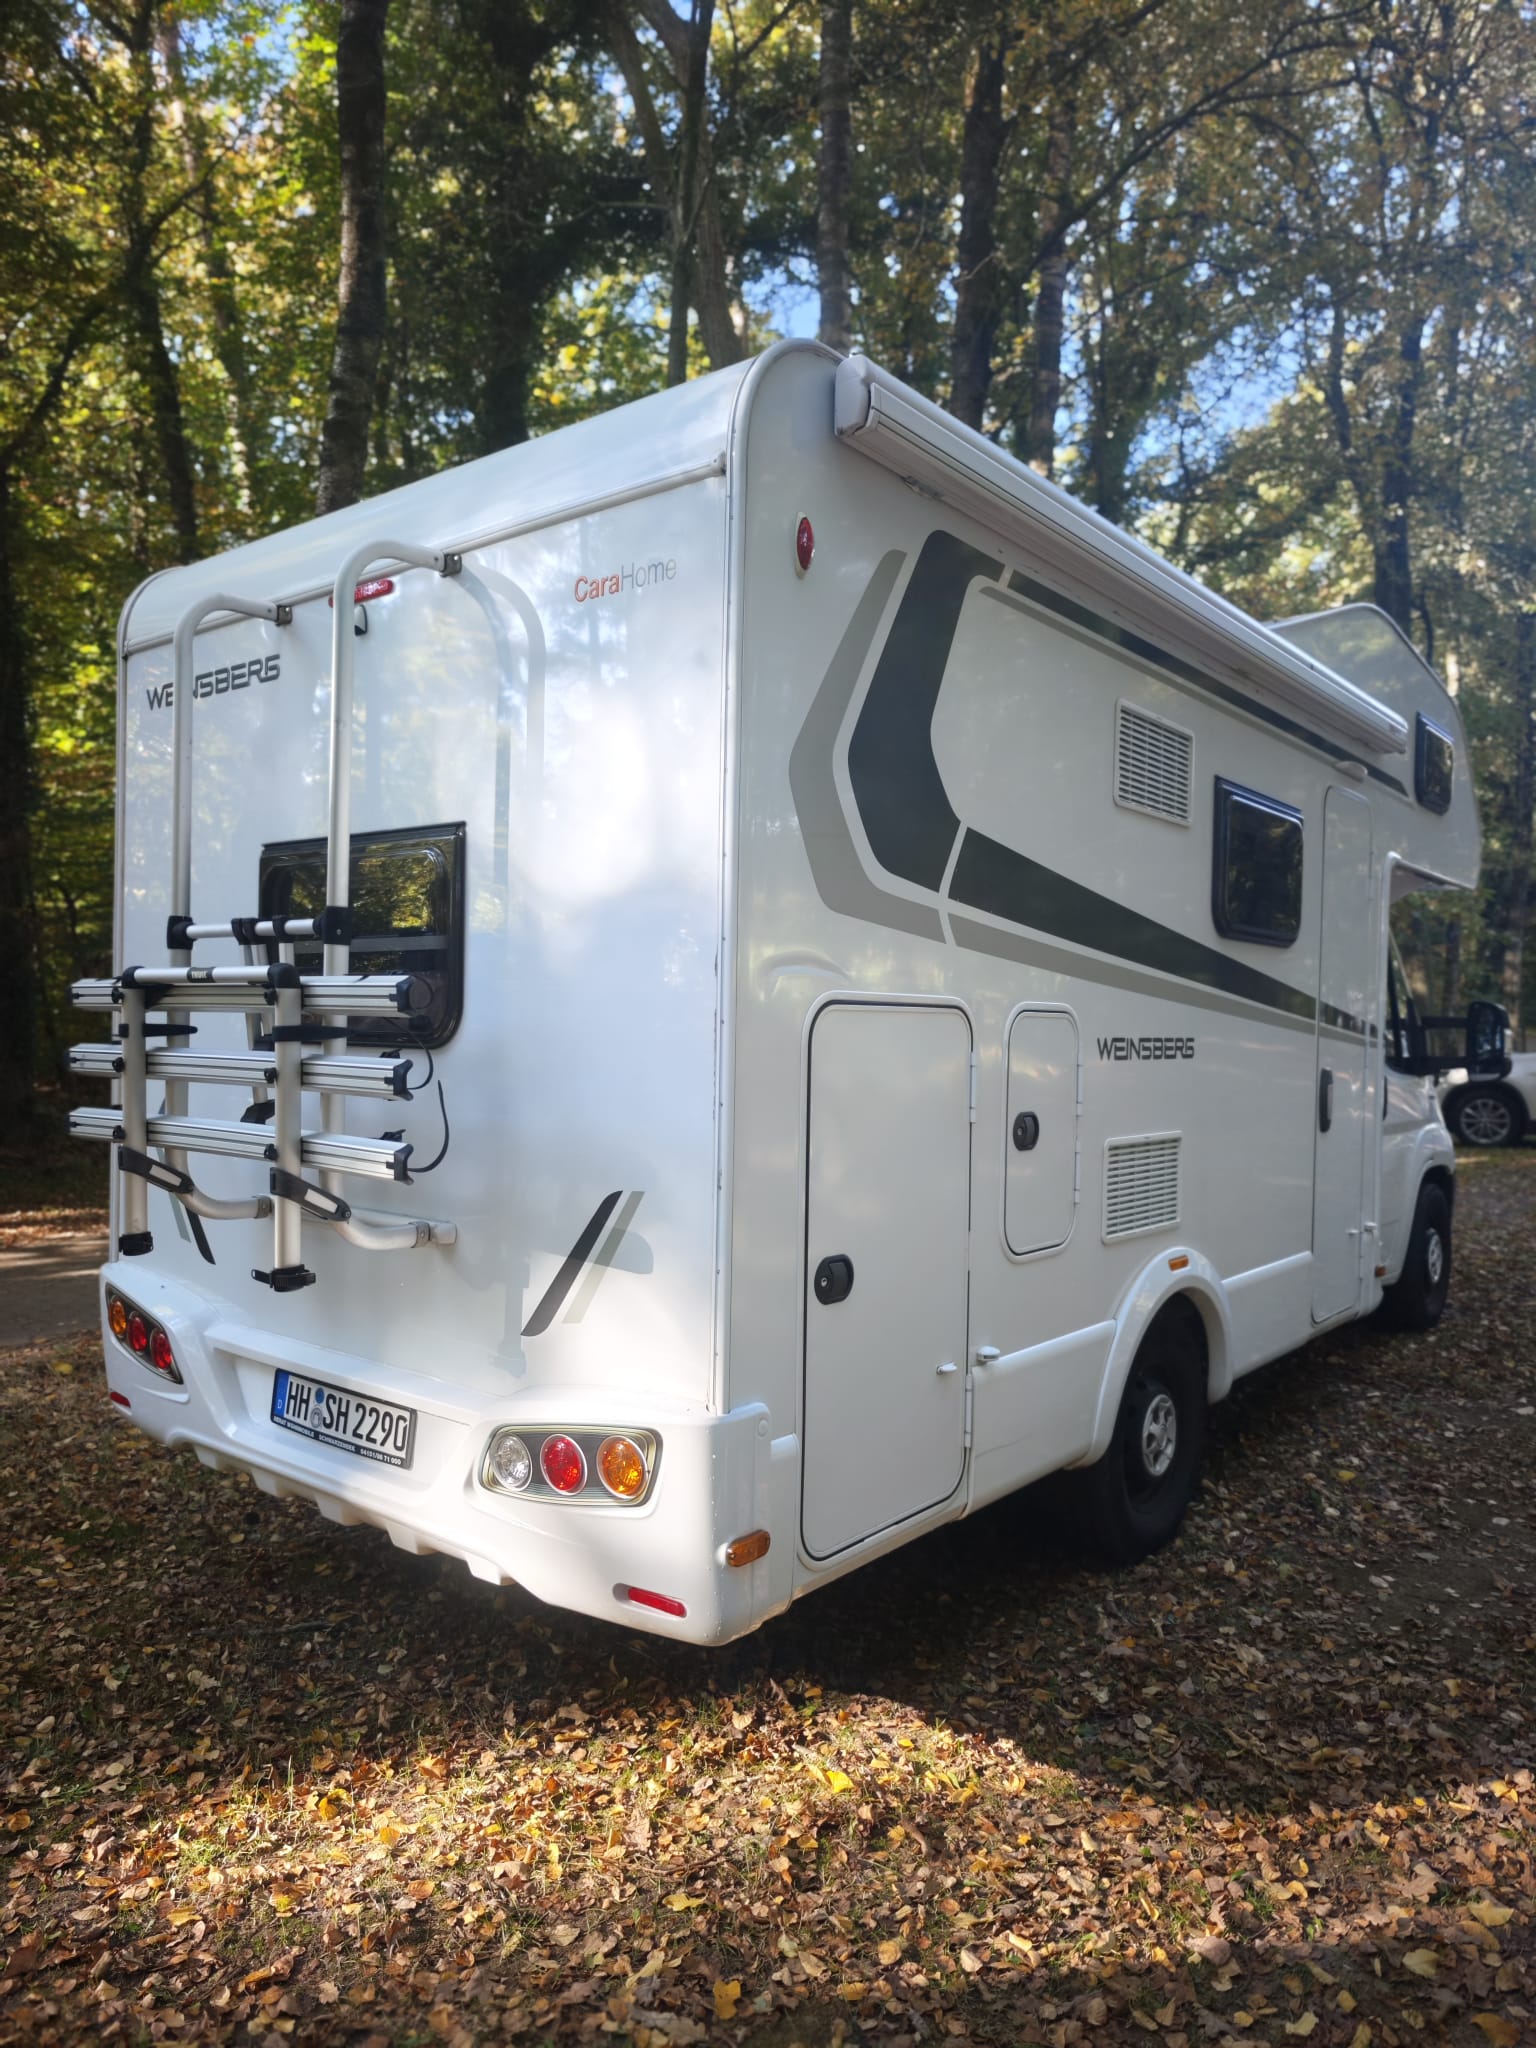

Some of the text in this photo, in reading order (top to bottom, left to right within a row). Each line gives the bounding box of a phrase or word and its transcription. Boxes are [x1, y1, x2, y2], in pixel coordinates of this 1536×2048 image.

[574, 558, 678, 603] CaraHome
[146, 653, 281, 711] WESBERG
[1096, 1037, 1195, 1061] WEINSBERG
[286, 1380, 408, 1453] HH SH 2290
